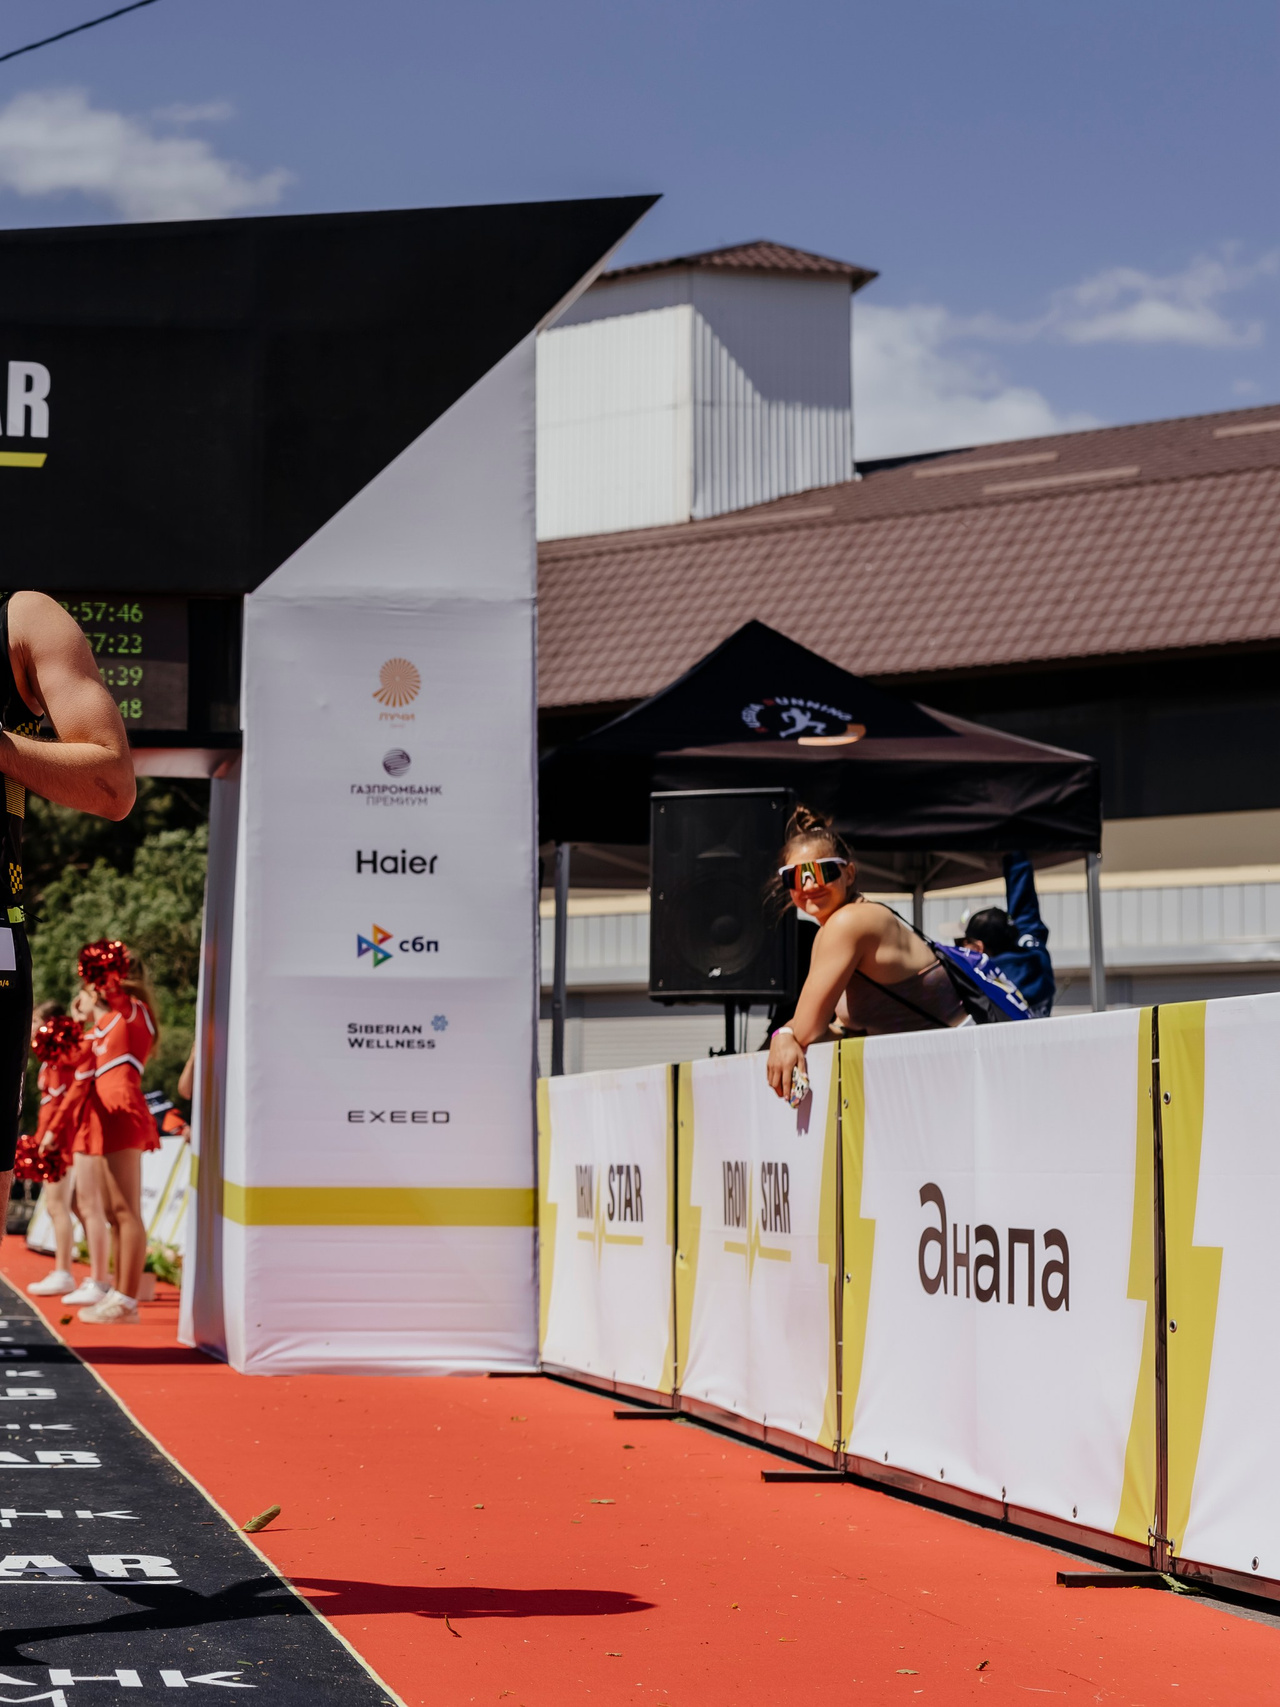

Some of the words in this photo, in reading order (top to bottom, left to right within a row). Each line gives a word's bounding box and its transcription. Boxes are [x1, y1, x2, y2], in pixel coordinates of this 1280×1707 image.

[350, 784, 442, 795] ГАЗПРОМБАНК
[366, 796, 428, 806] ПРЕМИУМ
[356, 848, 438, 875] Haier
[399, 935, 439, 953] сбп
[0, 980, 10, 988] 1/4
[347, 1110, 450, 1125] EXEED
[607, 1164, 644, 1223] STAR
[722, 1160, 747, 1228] IRON
[761, 1161, 791, 1234] STAR
